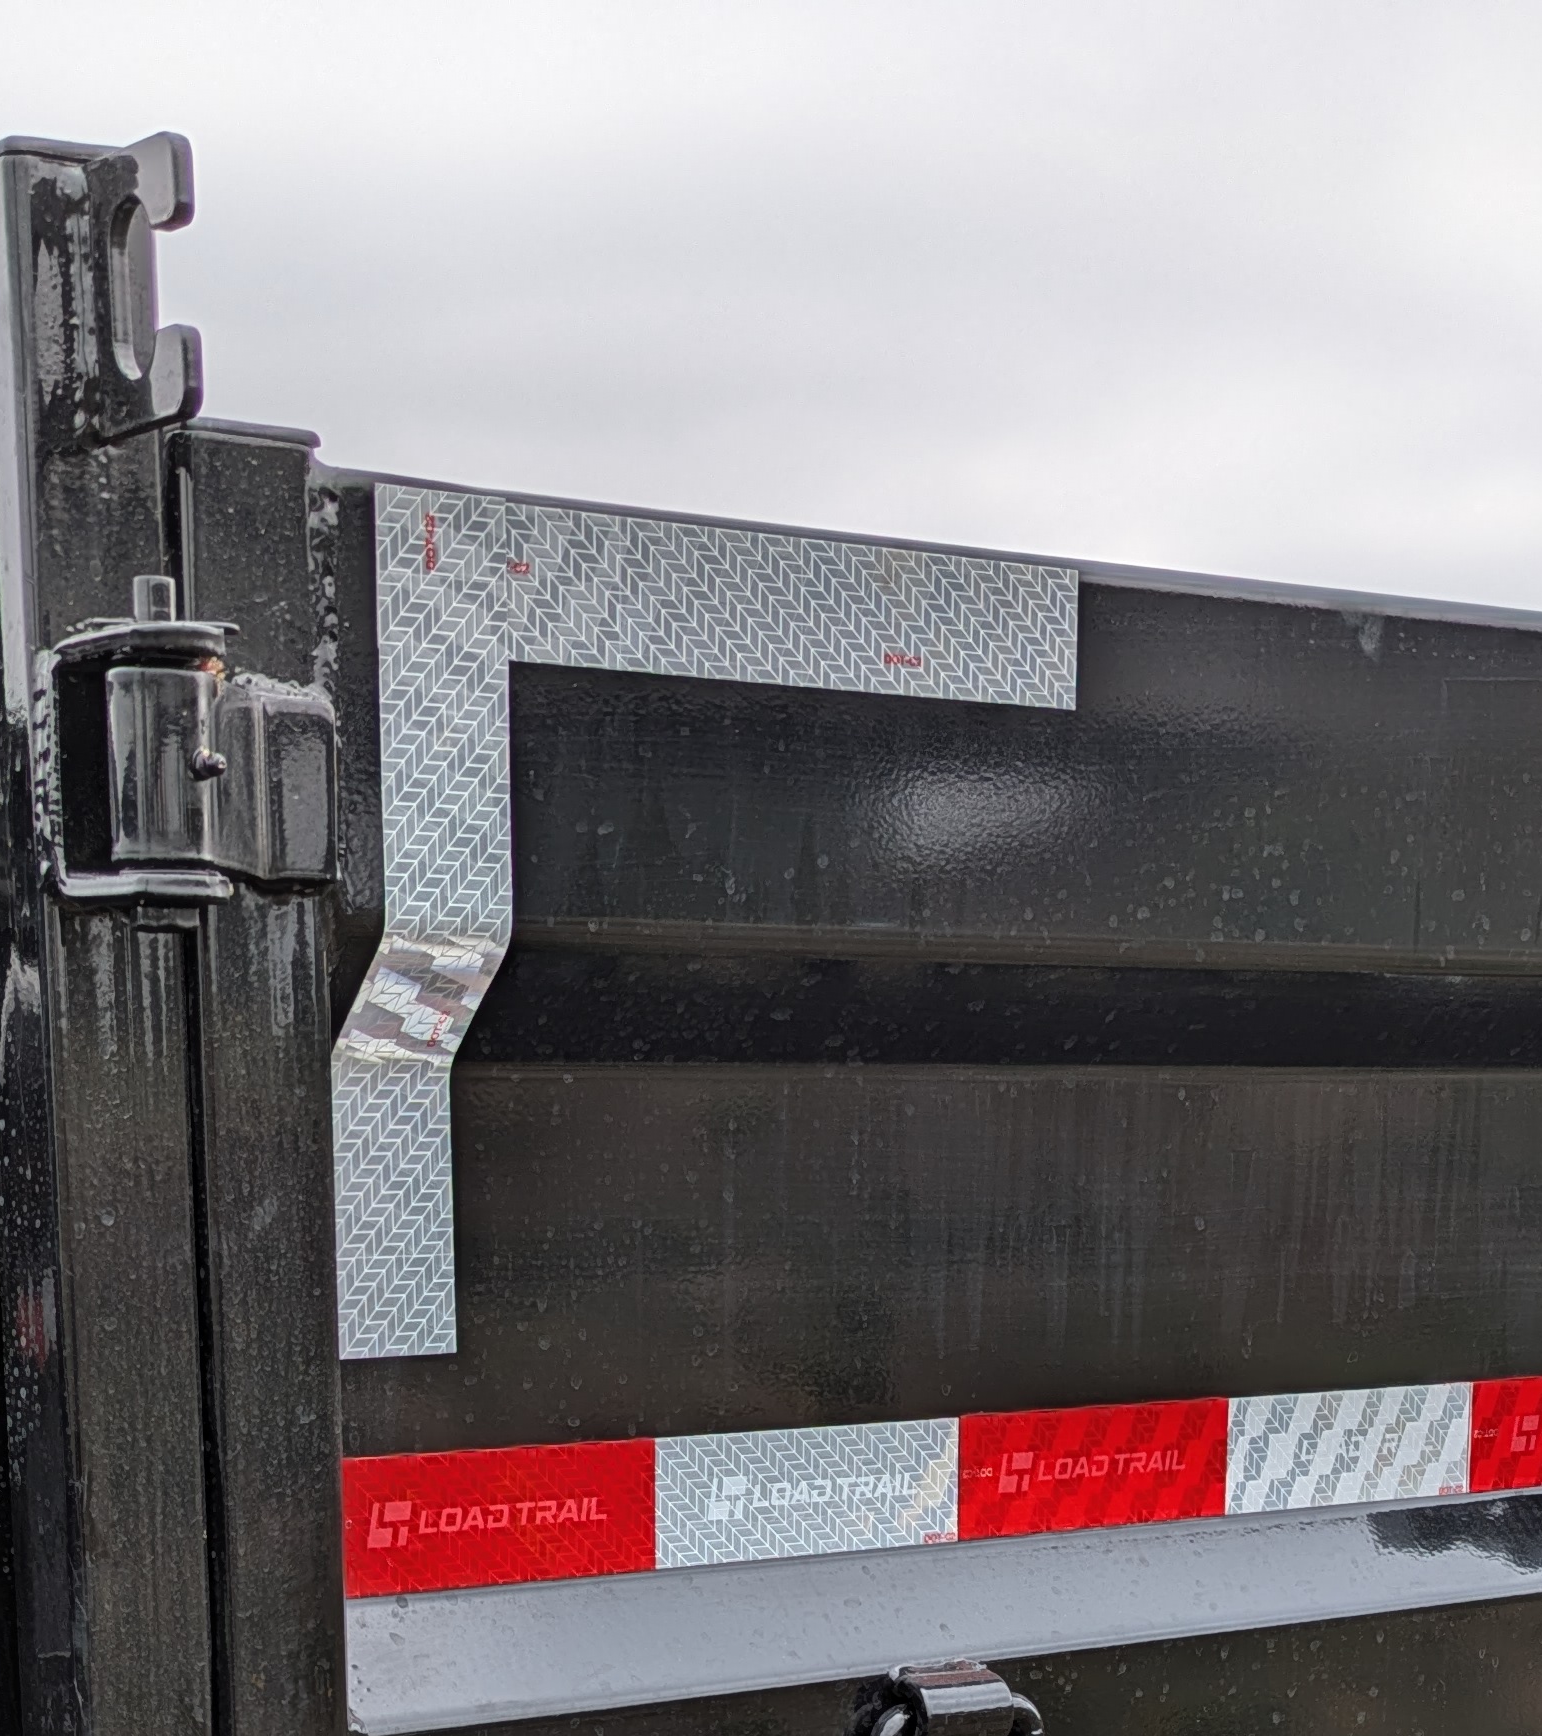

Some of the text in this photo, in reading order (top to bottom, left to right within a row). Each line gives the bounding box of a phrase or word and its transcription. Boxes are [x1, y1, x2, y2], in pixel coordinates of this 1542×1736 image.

[1037, 1449, 1186, 1481] LOAD TRAIL
[752, 1472, 918, 1507] LOAD TRAIL
[419, 1497, 608, 1535] LOAD TRAIL
